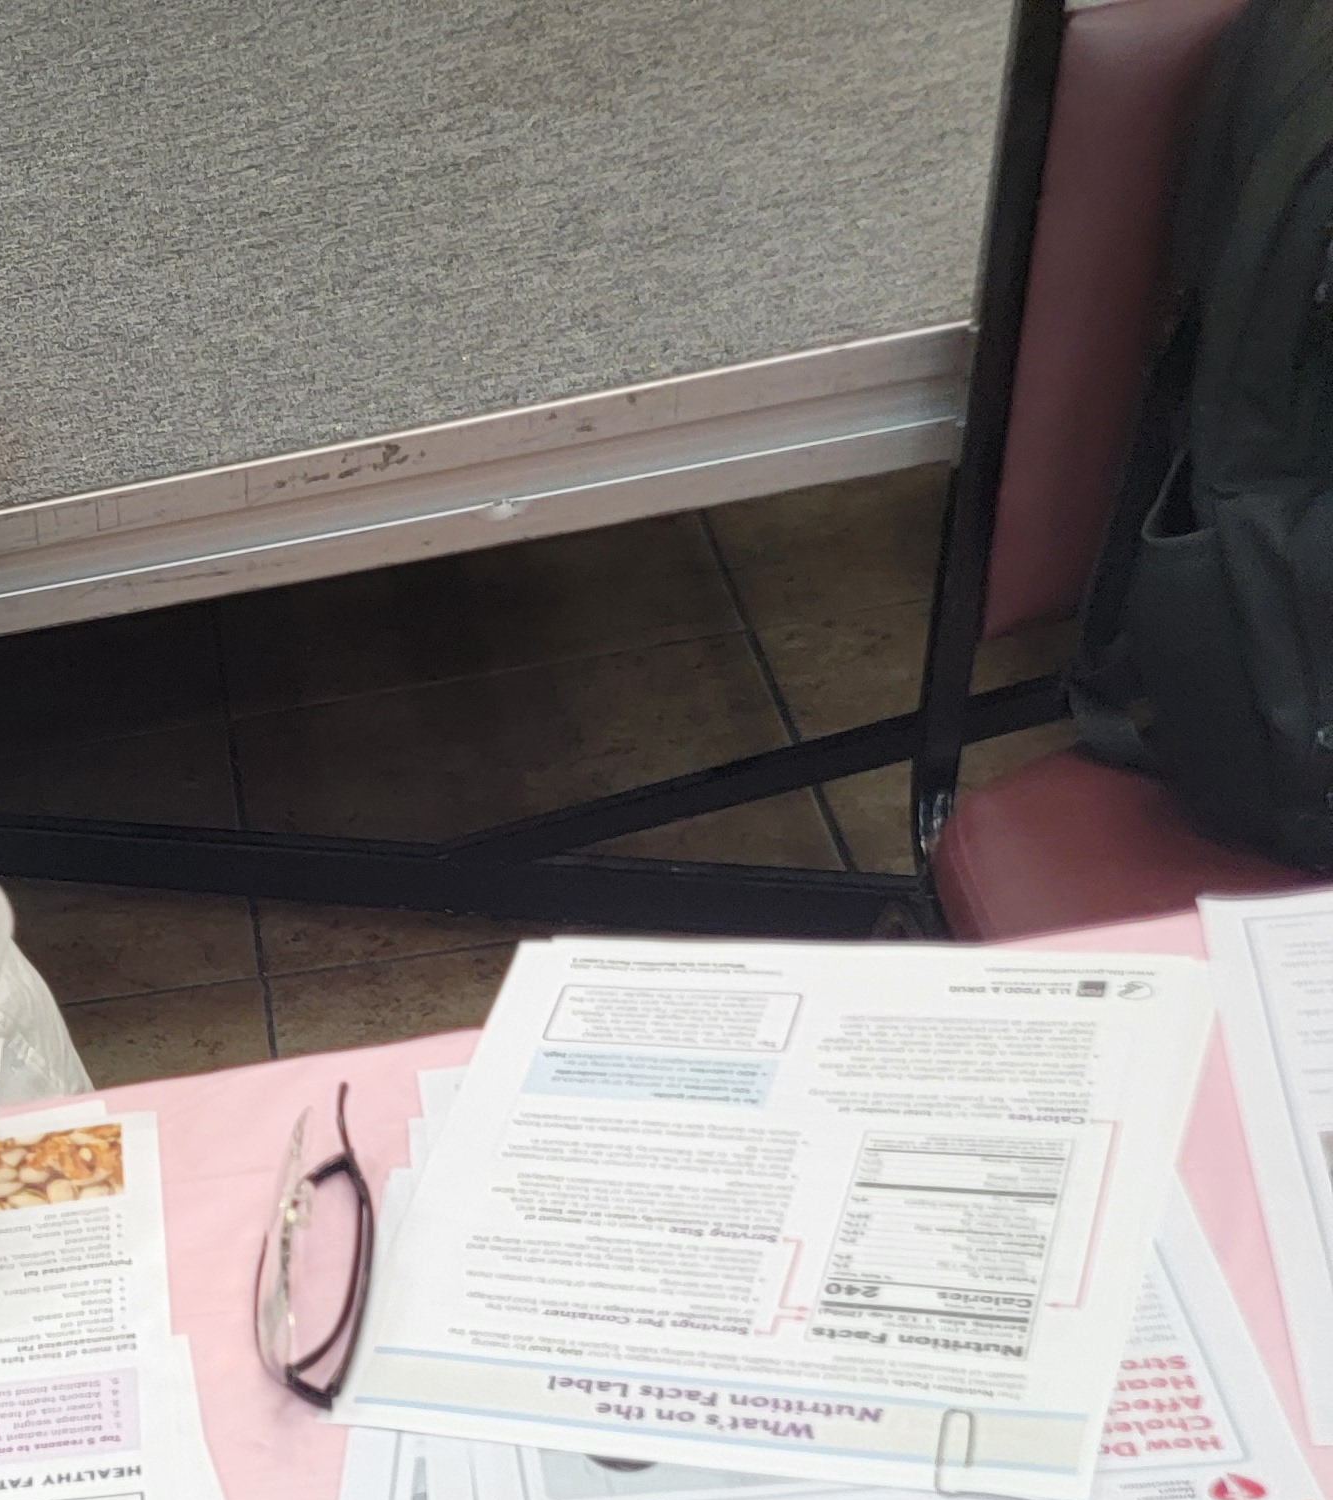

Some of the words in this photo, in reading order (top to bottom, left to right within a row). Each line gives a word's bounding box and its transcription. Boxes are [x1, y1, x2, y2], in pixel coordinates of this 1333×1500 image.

[824, 1282, 881, 1299] 240
[934, 1287, 1035, 1309] Calories
[811, 1326, 889, 1345] Facts
[898, 1334, 1024, 1358] Nutrition
[546, 1375, 630, 1399] Label
[638, 1384, 719, 1408] Facts
[594, 1402, 646, 1421] the
[655, 1408, 697, 1423] on
[729, 1393, 884, 1424] Nutrition
[705, 1413, 815, 1440] What's
[1145, 1434, 1224, 1452] How
[42, 1465, 142, 1486] HEALTHY
